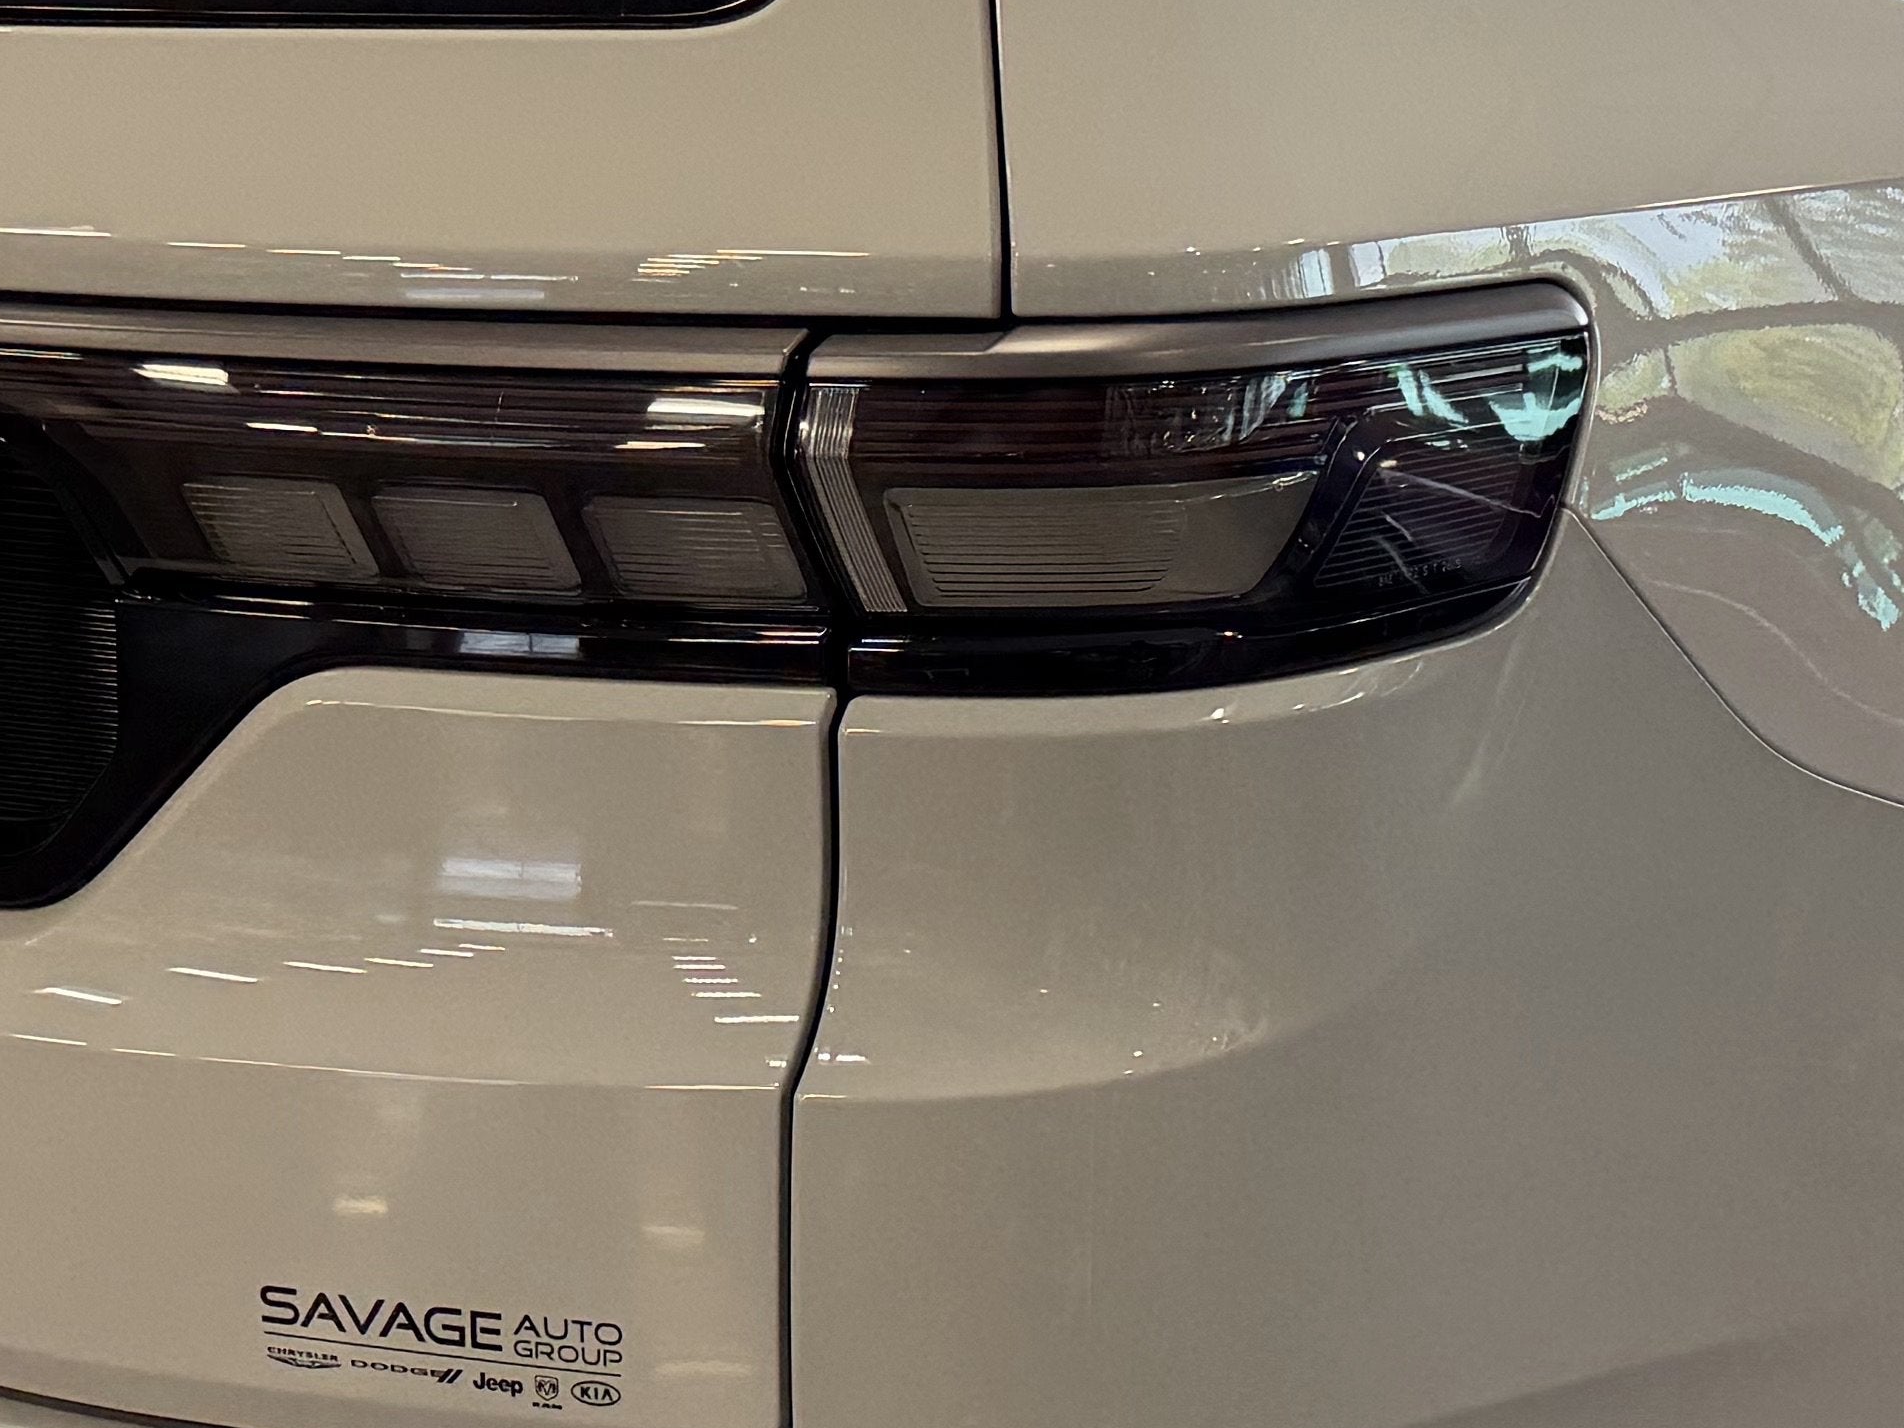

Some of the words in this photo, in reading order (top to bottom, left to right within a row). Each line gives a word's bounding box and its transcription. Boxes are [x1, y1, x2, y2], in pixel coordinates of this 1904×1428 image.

[260, 1285, 503, 1352] SAVAGE
[513, 1314, 623, 1346] AUTO
[267, 1346, 338, 1361] CHRYSLER
[473, 1372, 523, 1397] Jeep
[577, 1384, 615, 1403] KIA
[513, 1340, 623, 1367] GROUP
